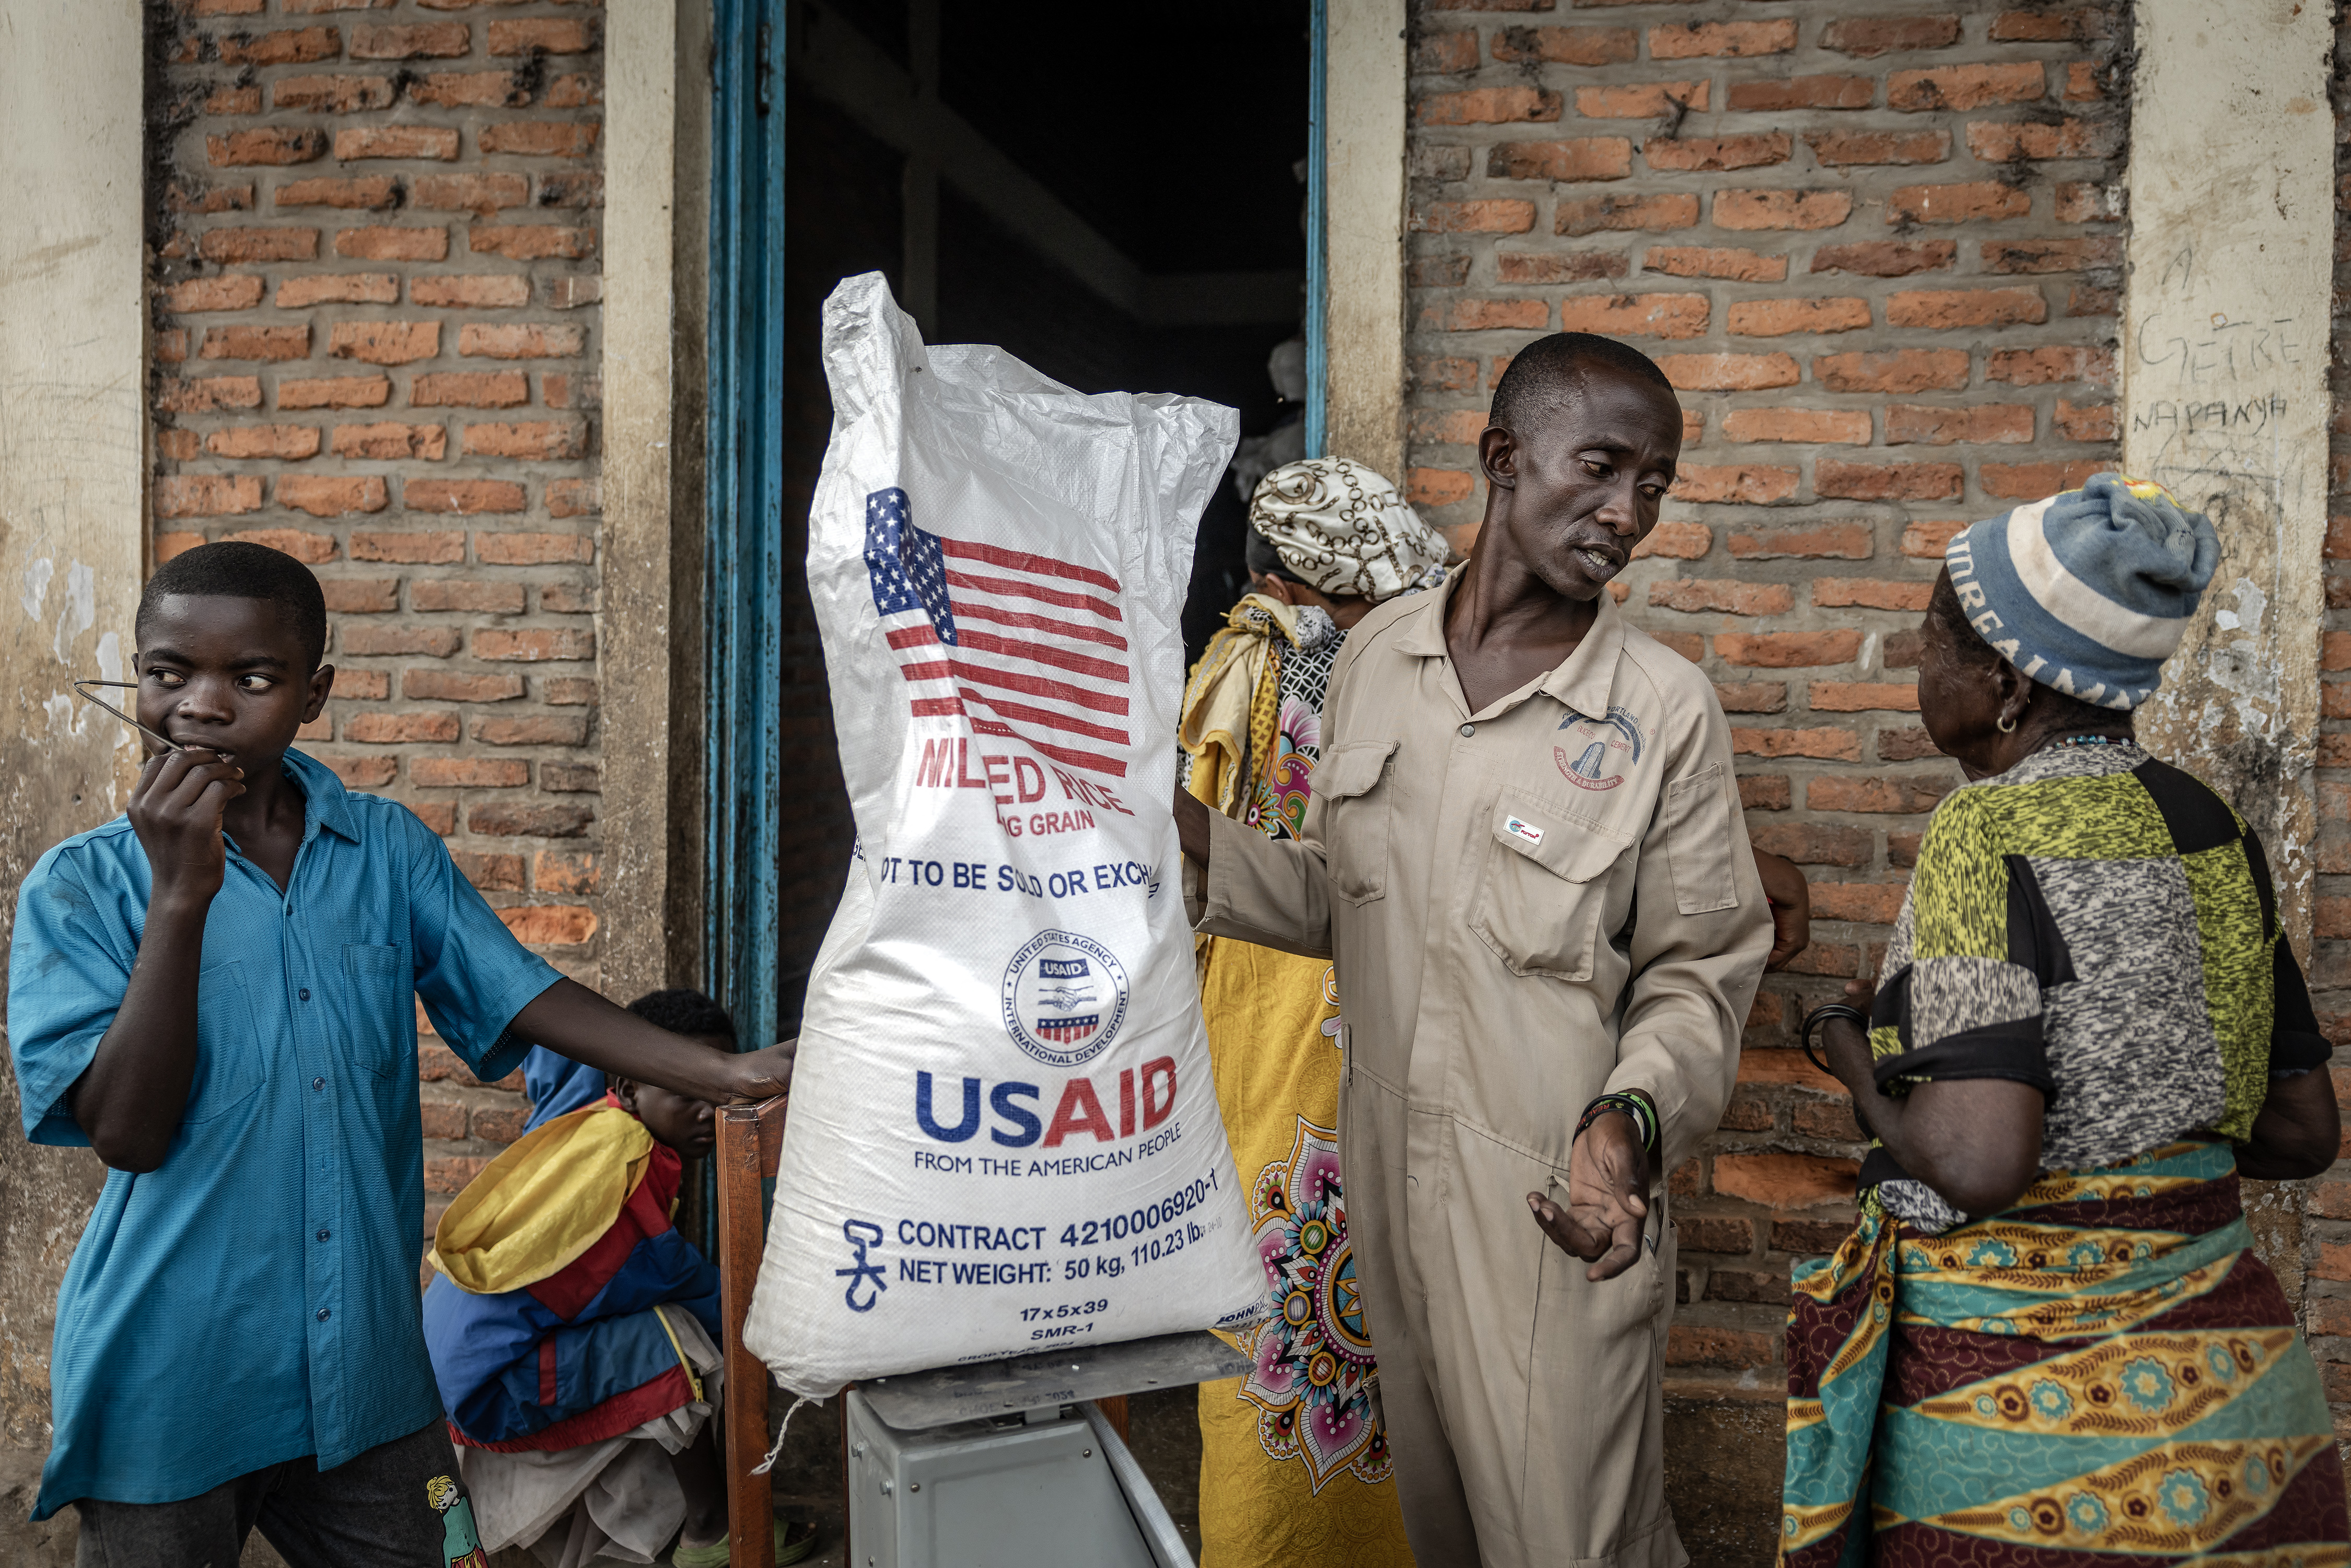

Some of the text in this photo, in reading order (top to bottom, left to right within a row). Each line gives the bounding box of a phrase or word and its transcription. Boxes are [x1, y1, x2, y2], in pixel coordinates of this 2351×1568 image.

[1607, 706, 1638, 724] PORTLAND
[1611, 740, 1631, 753] CEMENT
[916, 738, 1136, 816] MILED RICE
[1556, 752, 1578, 781] STRENGTH
[1581, 777, 1618, 789] DURABILITY
[1030, 809, 1096, 836] GRAIN
[881, 857, 1153, 898] OT TO BE SOLD OR EXCH
[1009, 932, 1117, 974] UNITED STATES AGENCY
[1044, 962, 1083, 976] USAID
[1005, 989, 1127, 1063] INTERNATIONAL DEVELOPMENT
[916, 1055, 1178, 1149] USAID
[915, 1122, 1182, 1177] FROM THE AMERICAN PEOPLE
[898, 1167, 1219, 1250] CONTRACT 4210006920-1
[899, 1258, 948, 1284] NET
[952, 1261, 1052, 1285] WEIGHT:
[1064, 1257, 1090, 1280] 50
[1096, 1256, 1125, 1278] kg,
[1131, 1227, 1184, 1267] 110.23
[1030, 1322, 1095, 1341] SMR-1
[958, 1352, 997, 1362] CROP
